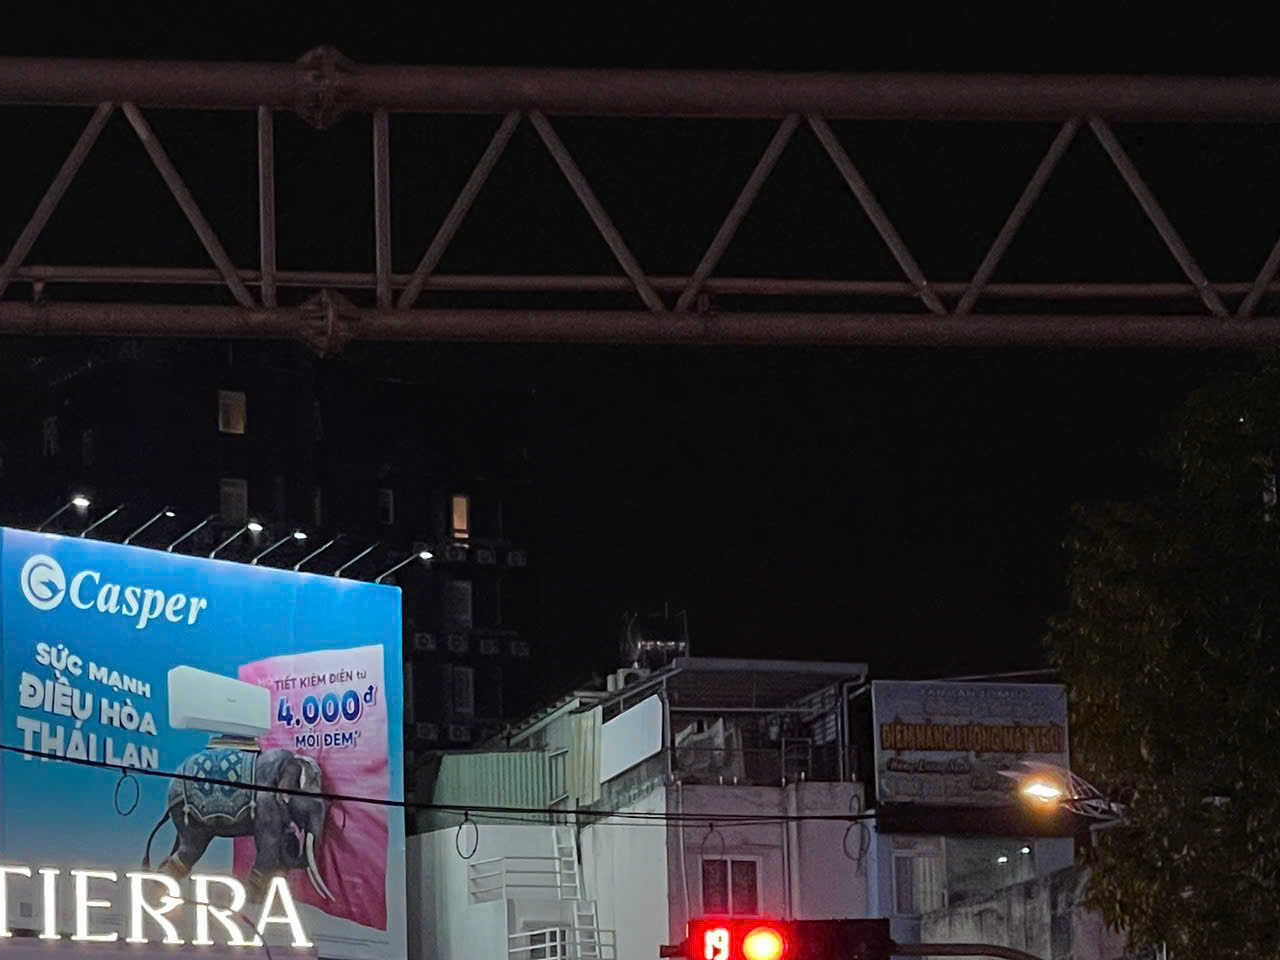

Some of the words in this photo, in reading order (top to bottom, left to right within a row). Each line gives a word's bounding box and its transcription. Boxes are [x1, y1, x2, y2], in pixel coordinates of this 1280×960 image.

[70, 569, 208, 630] Casper
[19, 669, 94, 721] ĐIỀU
[100, 698, 158, 736] HÒA
[88, 661, 151, 698] MẠNH
[17, 715, 98, 762] THÁI
[106, 736, 159, 770] LAN
